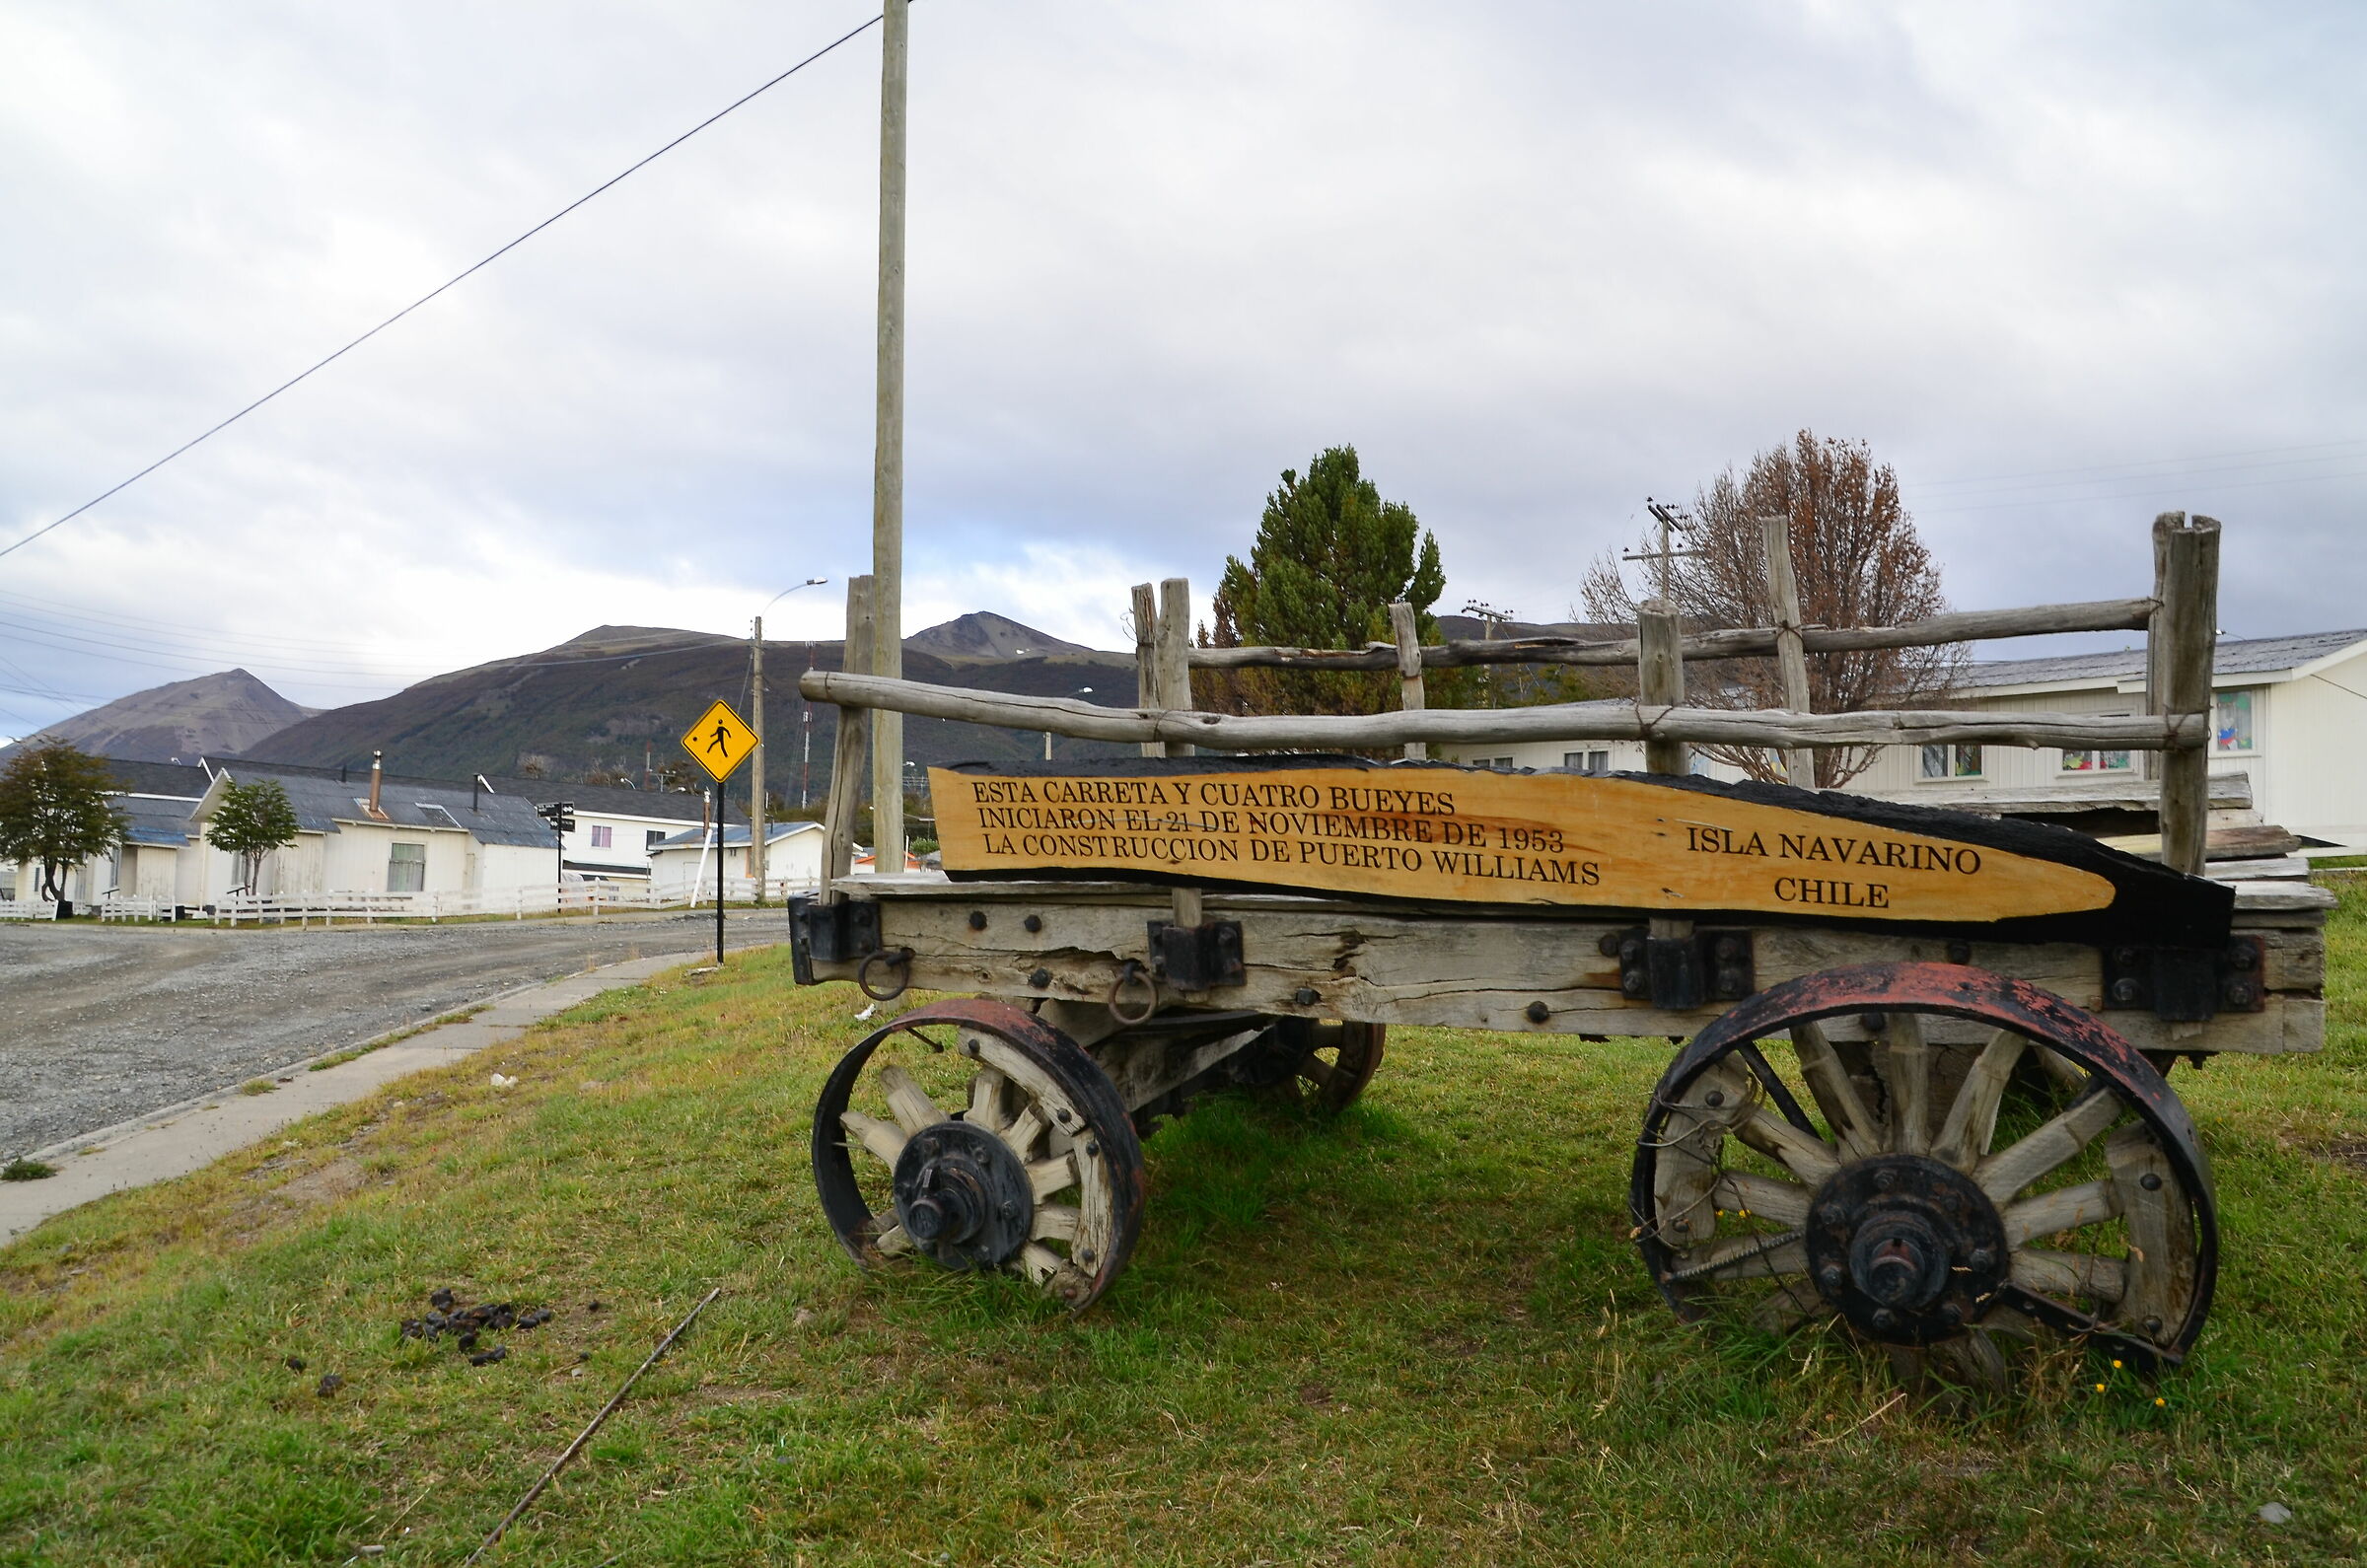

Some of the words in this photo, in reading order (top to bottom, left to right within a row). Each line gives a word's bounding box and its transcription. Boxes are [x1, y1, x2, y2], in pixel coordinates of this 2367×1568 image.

[971, 781, 1039, 804] ESTA
[1042, 781, 1168, 805] CARRETA
[1171, 782, 1191, 805] Y
[1200, 783, 1320, 808] CUATRO
[1327, 786, 1456, 817] BUEYES
[977, 808, 1116, 830] INICIARON
[1124, 810, 1160, 831] EL
[1166, 812, 1191, 832] 21
[1199, 811, 1240, 834] DE
[1248, 812, 1432, 843] NOVIEMBRE
[1441, 821, 1487, 848] DE
[1498, 827, 1565, 854] 1953
[1686, 826, 1770, 857] ISLA
[1778, 833, 1981, 876] NAVARINO
[982, 833, 1017, 856] LA
[1023, 834, 1239, 861] CONSTRUCCION
[1251, 838, 1291, 863] DE
[1299, 841, 1423, 873] PUERTO
[1431, 851, 1601, 887] WILLIAMS
[1774, 877, 1890, 909] CHILE
